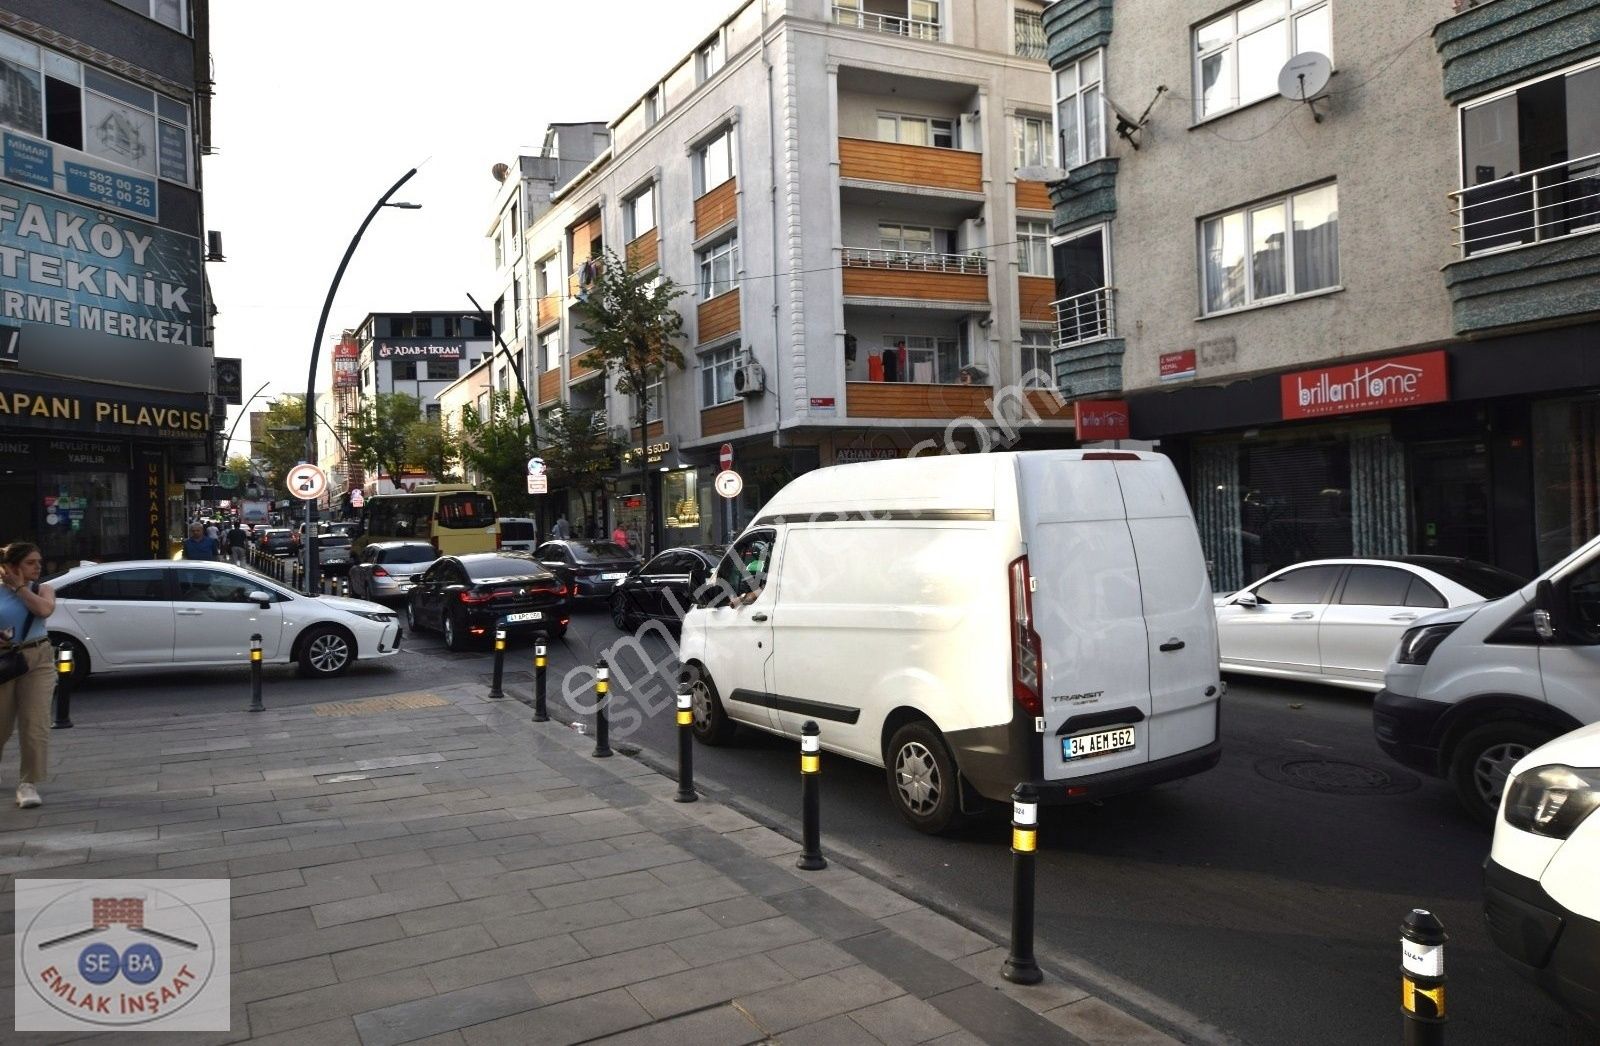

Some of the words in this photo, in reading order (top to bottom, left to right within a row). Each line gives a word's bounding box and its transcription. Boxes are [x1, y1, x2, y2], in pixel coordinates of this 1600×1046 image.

[89, 170, 112, 185] 592
[116, 179, 131, 191] 00
[135, 184, 150, 197] 22
[89, 182, 113, 197] 592
[116, 190, 132, 202] 00
[135, 196, 150, 208] 20
[79, 305, 192, 346] MERKEZİ
[653, 442, 670, 454] GOLD
[837, 449, 872, 459] AYHAN
[1051, 690, 1105, 702] TRANSIT
[1071, 739, 1085, 754] 34
[1089, 734, 1109, 752] AEM
[1112, 730, 1132, 747] 562
